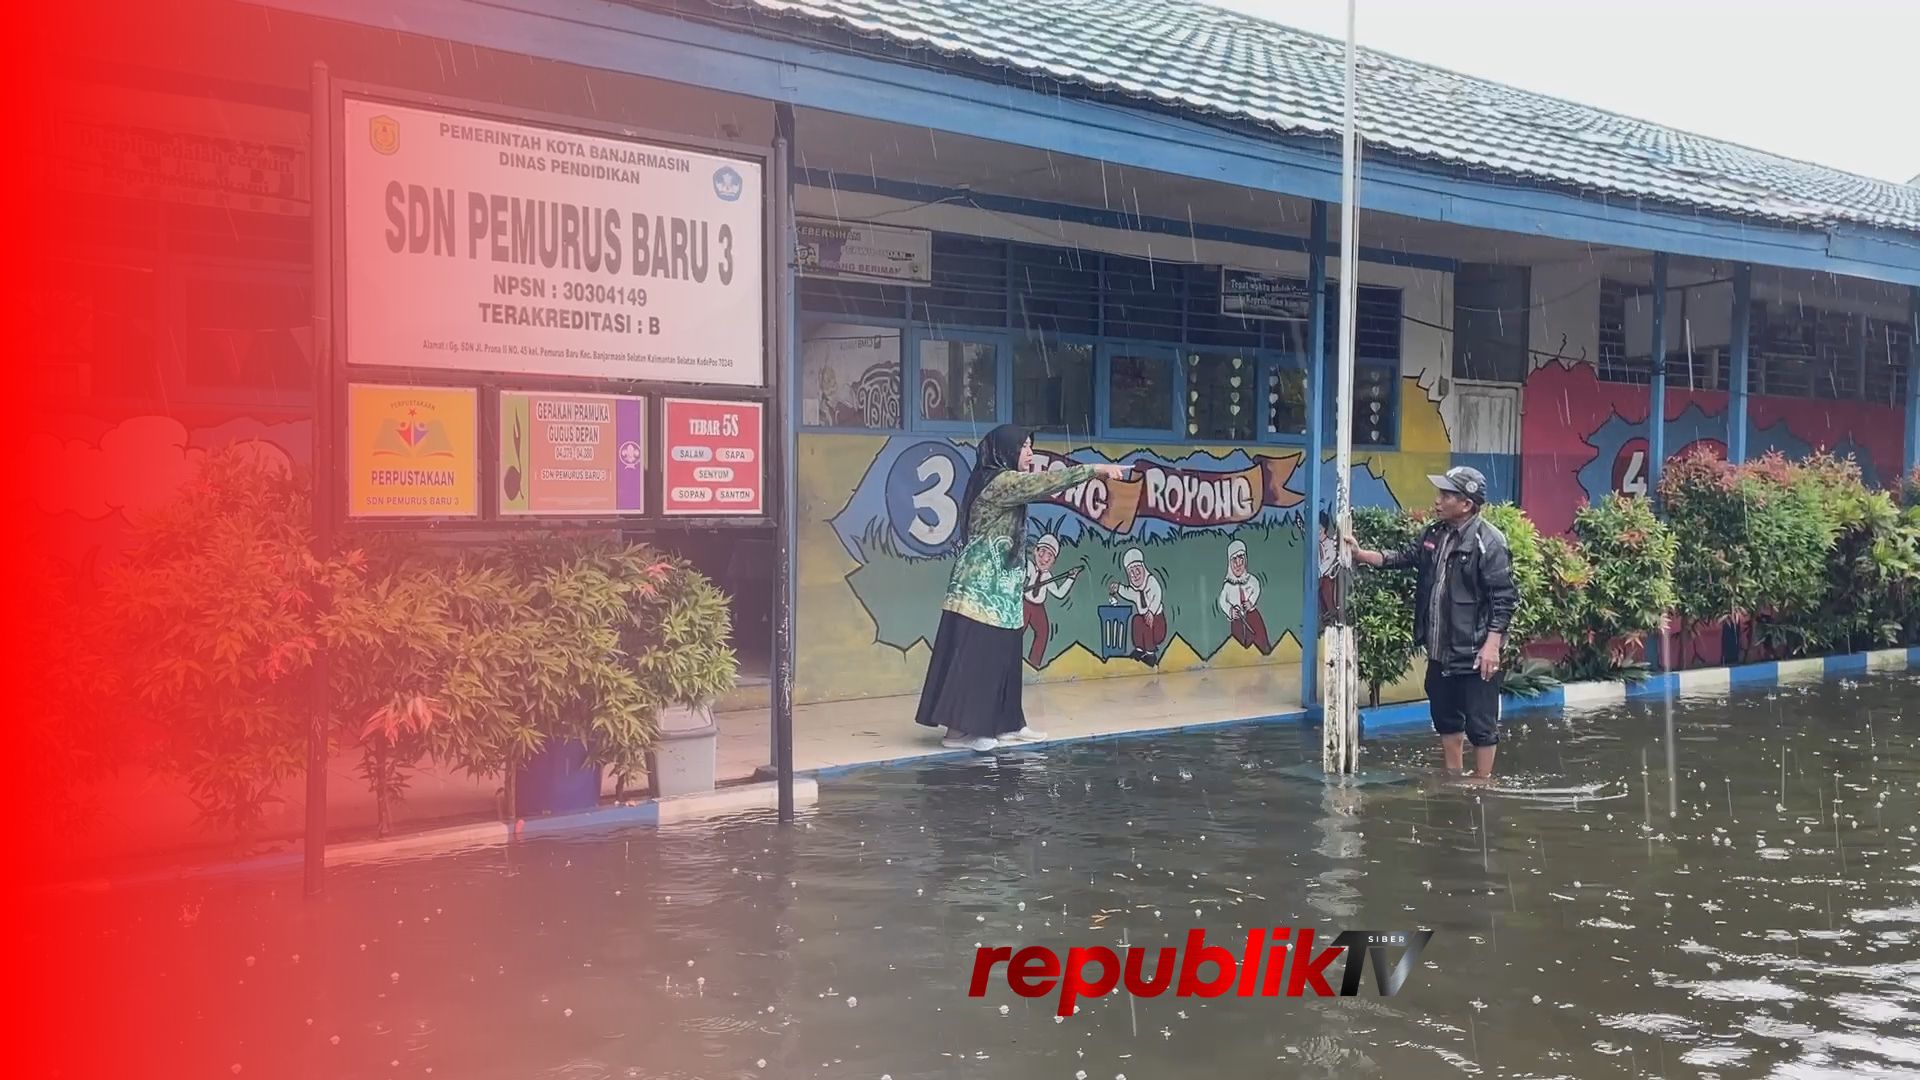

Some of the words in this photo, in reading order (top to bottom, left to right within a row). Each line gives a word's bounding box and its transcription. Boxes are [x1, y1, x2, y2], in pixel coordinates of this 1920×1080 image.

[439, 122, 541, 151] PEMERINTAH
[547, 139, 586, 158] KOTA
[590, 145, 691, 173] BANJARMASIN
[499, 152, 547, 172] DINAS
[551, 160, 641, 185] PENDIDIKAN
[384, 180, 456, 258] SDN
[467, 190, 622, 276] PEMURUS
[632, 211, 709, 284] BARU
[717, 222, 734, 287] 3
[493, 274, 546, 298] NPSN
[552, 284, 558, 299] :
[563, 281, 648, 307] 30304149
[478, 302, 632, 334] TERAKREDITASI
[638, 319, 643, 335] :
[648, 316, 661, 336] B
[537, 402, 572, 421] GERAKAN
[574, 404, 610, 423] PRAMUKA
[689, 418, 720, 435] TEBAR
[723, 413, 739, 437] 5S
[548, 425, 574, 443] GUGUS
[575, 426, 599, 443] DEPAN
[680, 449, 704, 458] SALAM
[725, 451, 745, 460] SAPA
[371, 470, 455, 487] PERPUSTAKAAN
[1622, 450, 1647, 497] 4
[366, 496, 385, 506] SDN
[387, 497, 430, 506] PEMURUS
[430, 497, 453, 506] BARU
[455, 498, 460, 506] 3
[679, 490, 706, 499] SOPAN
[908, 455, 958, 544] 3
[1148, 471, 1254, 517] ROYONG
